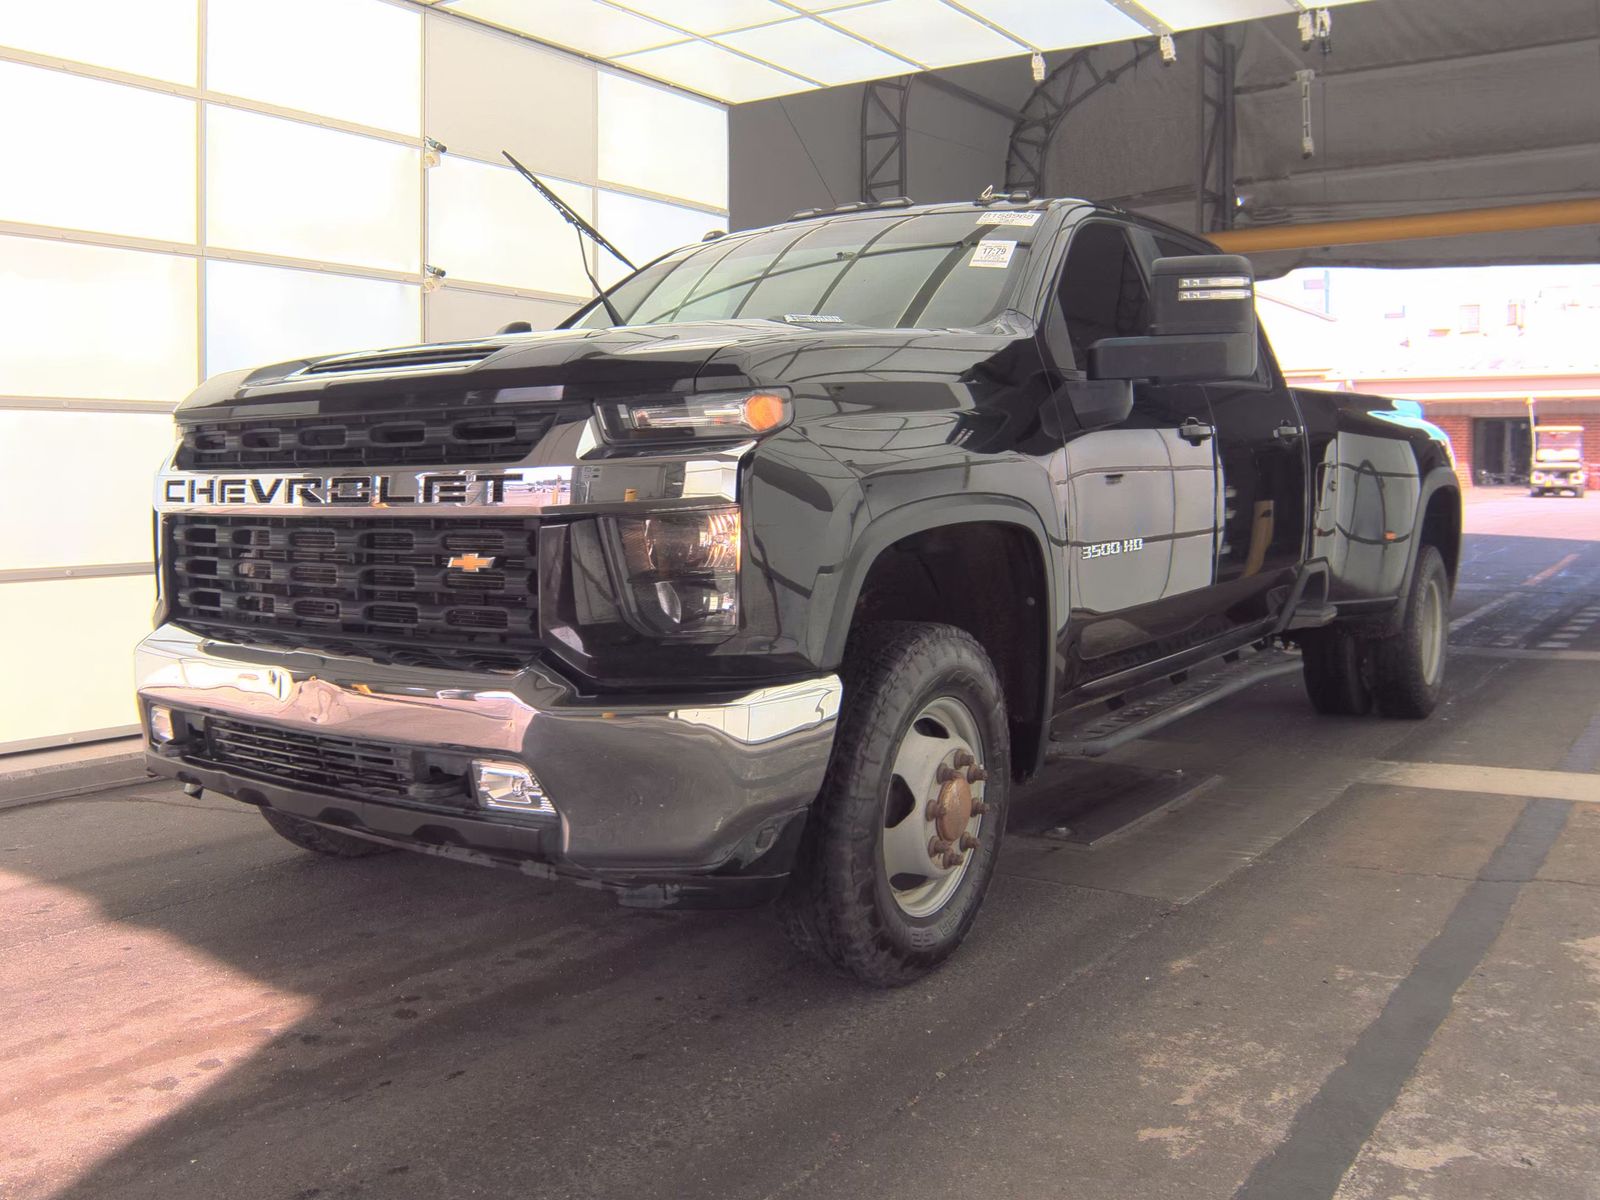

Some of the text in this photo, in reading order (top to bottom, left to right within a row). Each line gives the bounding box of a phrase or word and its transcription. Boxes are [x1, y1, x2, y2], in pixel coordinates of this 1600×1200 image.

[164, 472, 524, 505] CHEVROLET
[1082, 538, 1143, 560] 3500 HD
